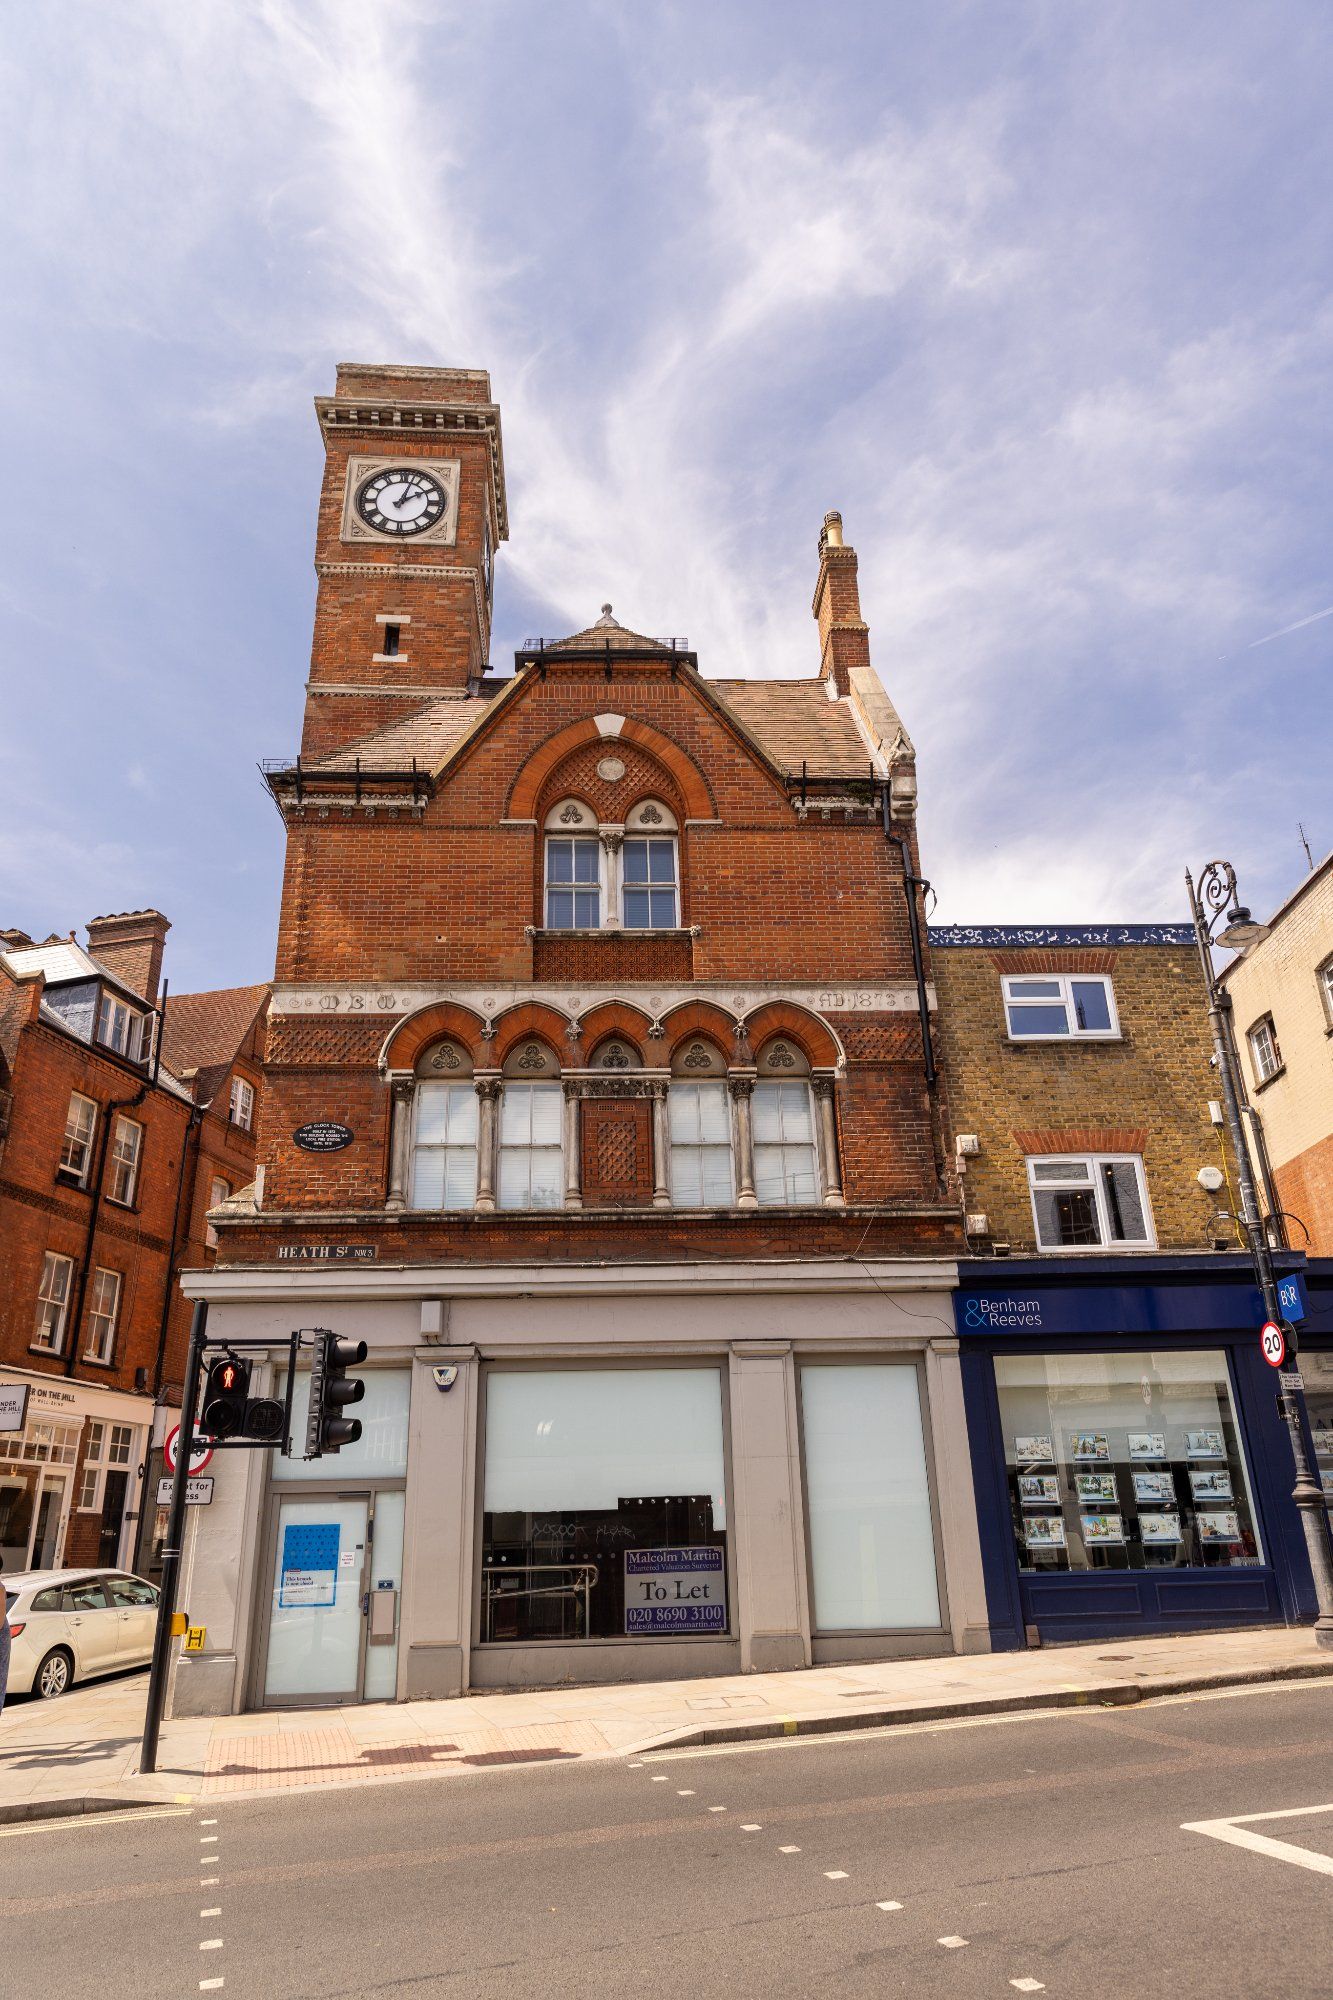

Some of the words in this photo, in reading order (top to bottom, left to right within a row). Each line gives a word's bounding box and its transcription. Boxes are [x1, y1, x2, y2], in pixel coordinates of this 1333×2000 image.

[278, 1246, 330, 1258] HEATH
[1280, 1284, 1298, 1308] B&R
[965, 1299, 988, 1327] &
[989, 1312, 1042, 1327] Reeves
[980, 1297, 1040, 1313] Benham
[1264, 1334, 1281, 1355] 20
[37, 1389, 48, 1398] ON
[49, 1390, 61, 1400] THE
[62, 1393, 76, 1403] HILL
[162, 1482, 193, 1491] Ext
[195, 1482, 209, 1490] for
[629, 1551, 678, 1564] Malcolm
[681, 1550, 719, 1561] Martin
[628, 1564, 660, 1572] Chartered
[661, 1563, 690, 1571] Valuation
[639, 1580, 667, 1601] To
[673, 1580, 710, 1600] Let
[629, 1608, 652, 1622] 020
[656, 1607, 688, 1621] 8690
[691, 1606, 721, 1620] 3100
[628, 1621, 722, 1631] sales@malcolmmartin.net
[187, 1629, 203, 1648] H
